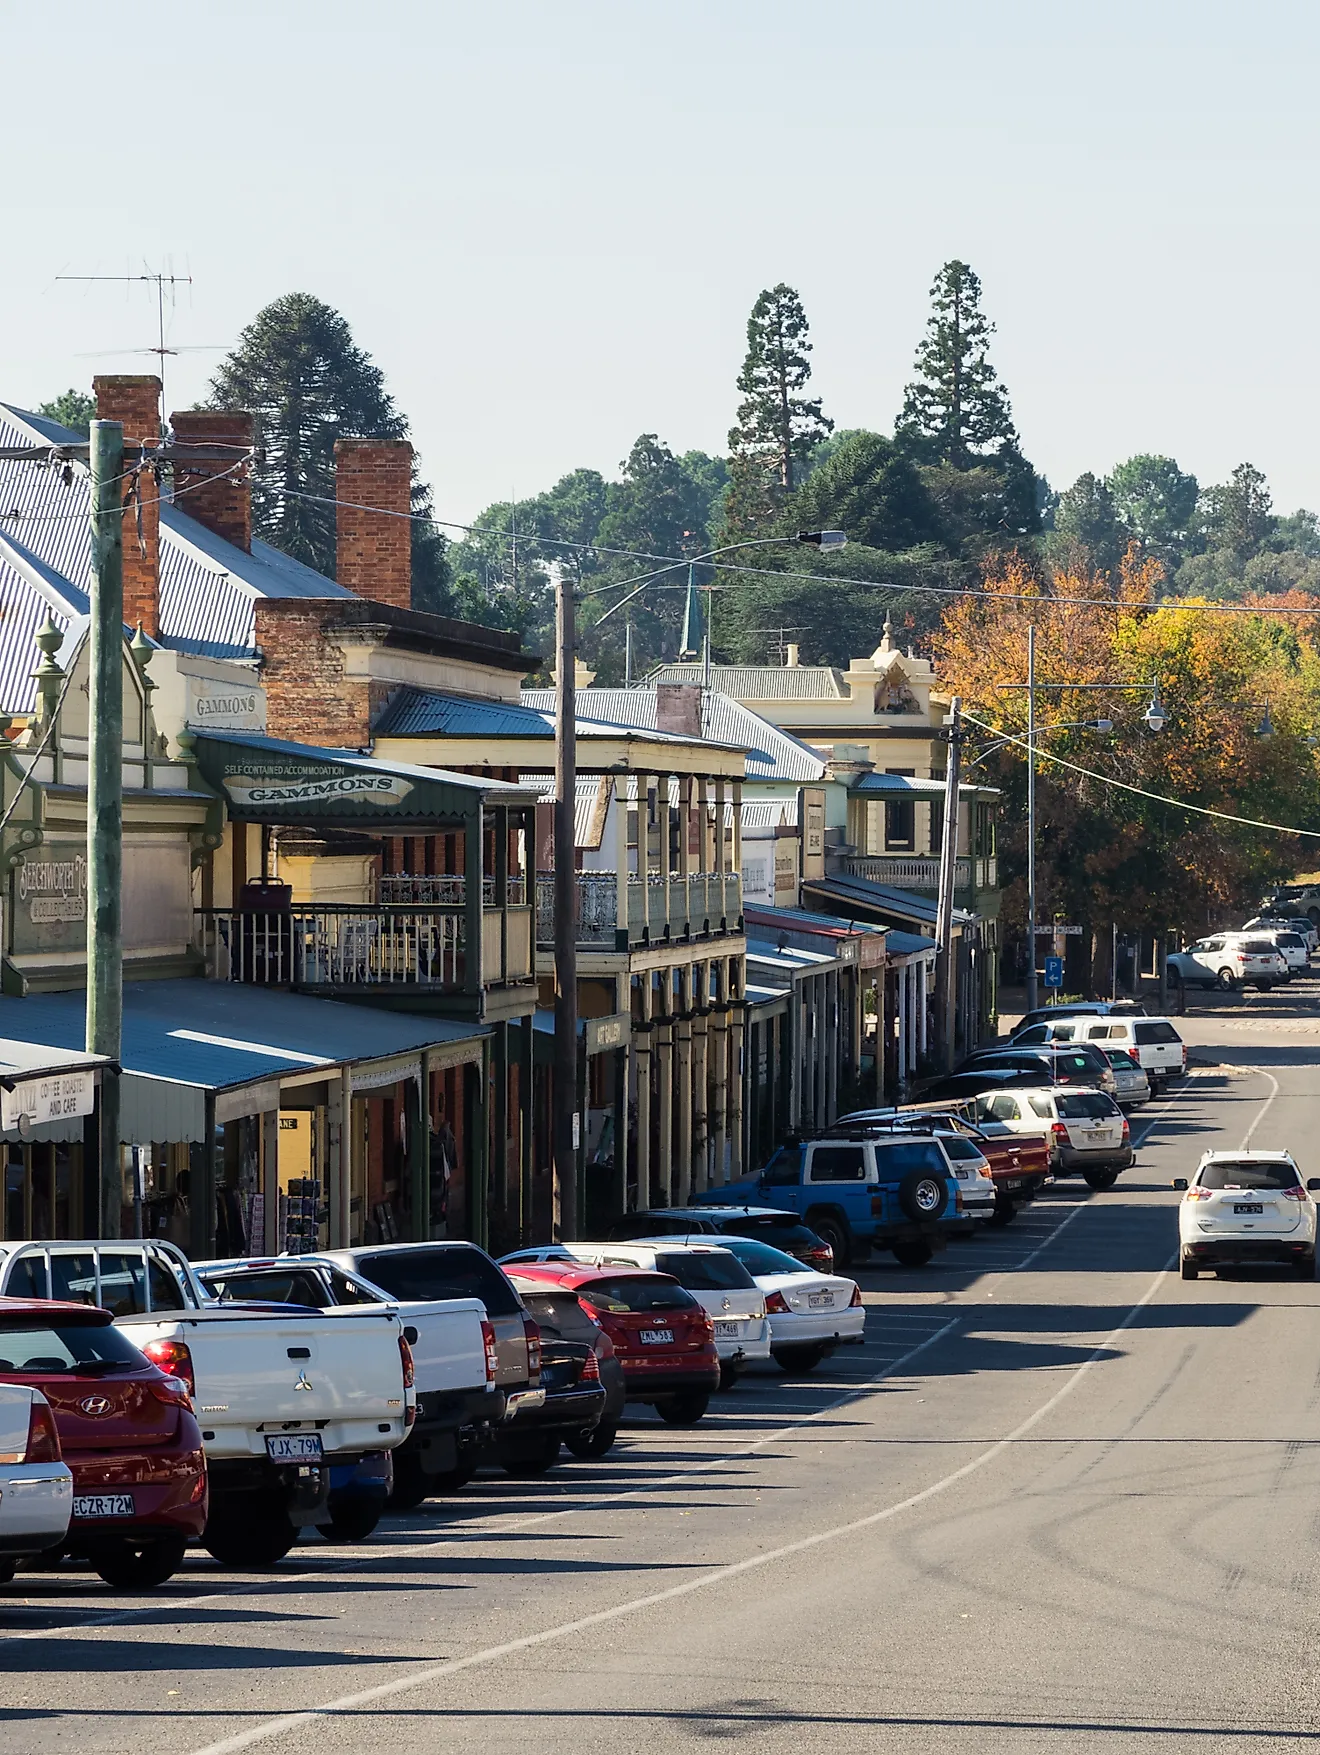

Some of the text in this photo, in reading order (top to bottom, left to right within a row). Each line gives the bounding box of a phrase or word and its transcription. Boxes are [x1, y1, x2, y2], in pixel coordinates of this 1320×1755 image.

[224, 764, 345, 776] SELF CONTAINED ACCOMMODATION
[248, 777, 393, 802] GAMMONS
[63, 1097, 77, 1114] CAFE
